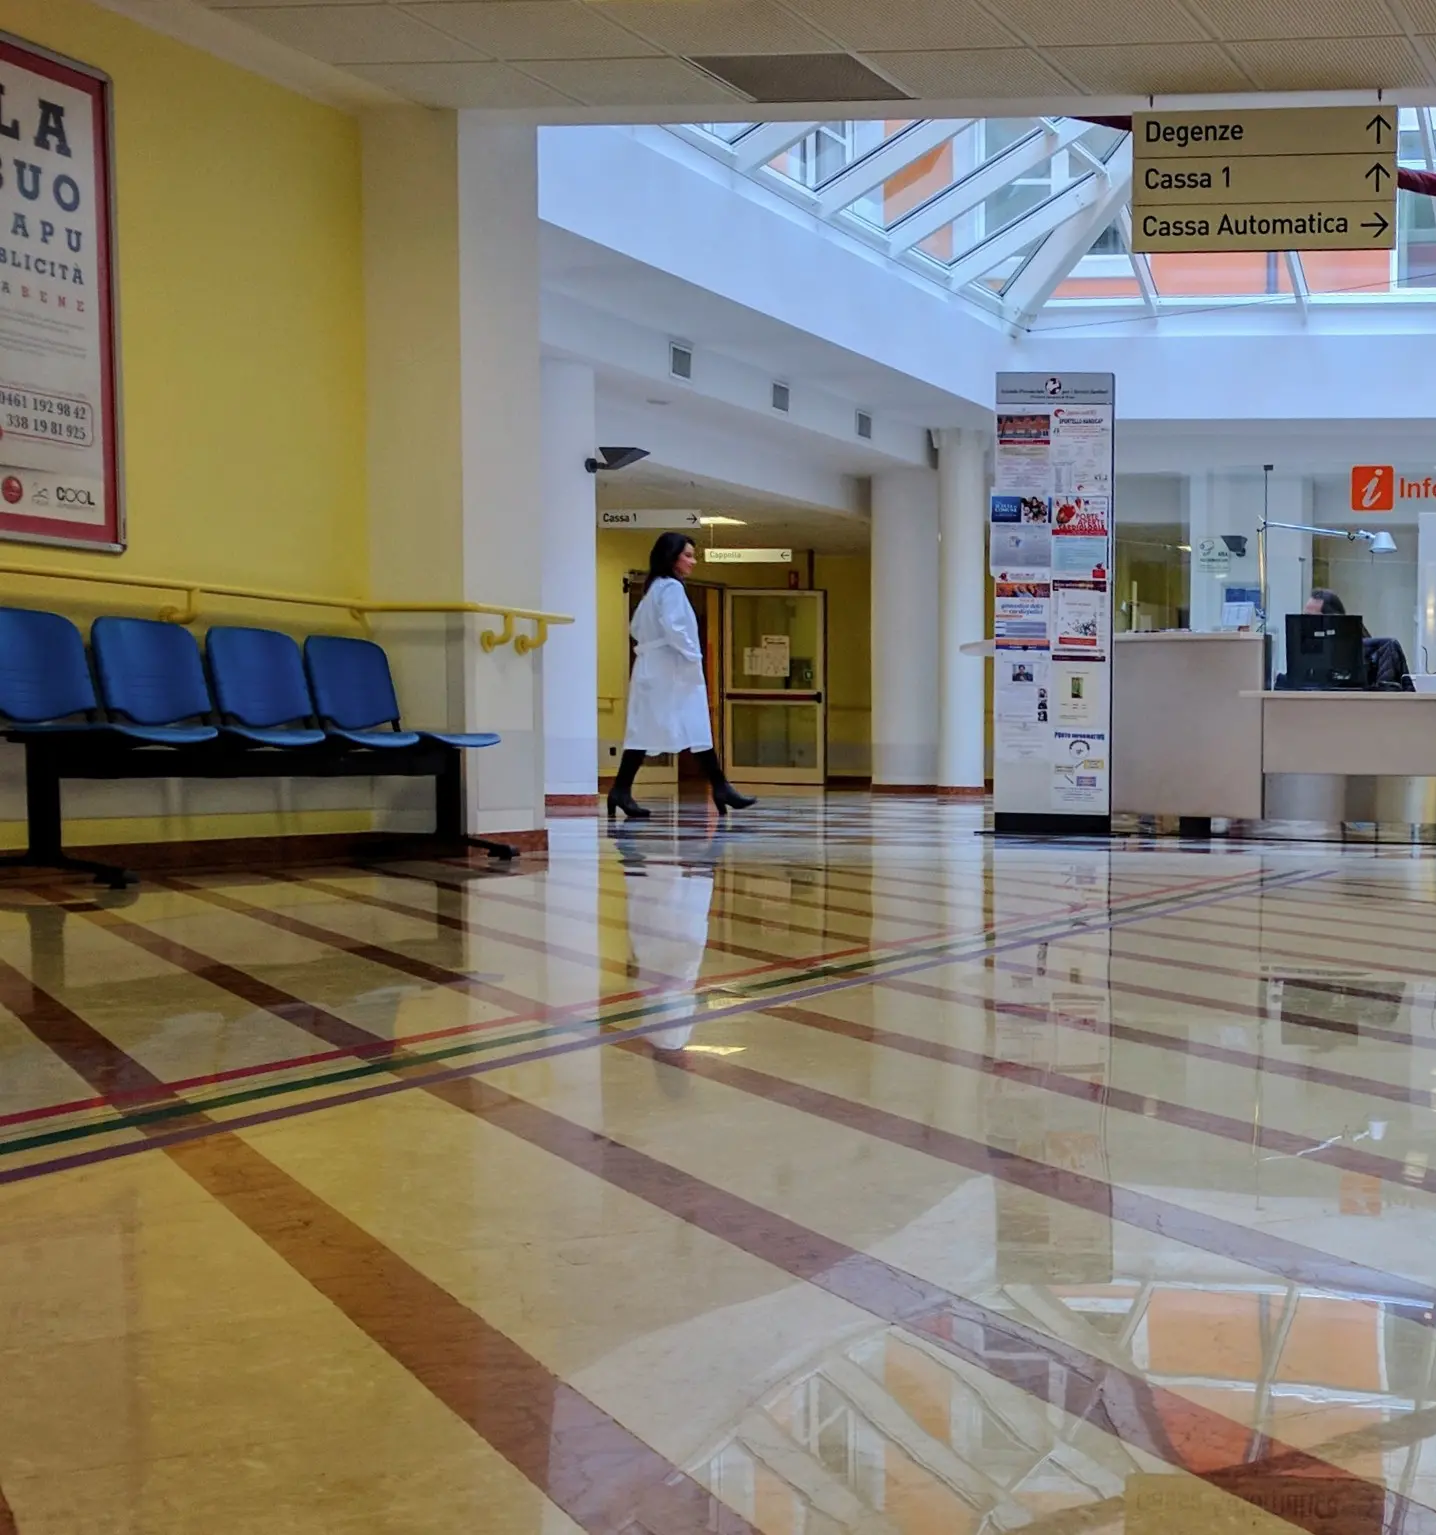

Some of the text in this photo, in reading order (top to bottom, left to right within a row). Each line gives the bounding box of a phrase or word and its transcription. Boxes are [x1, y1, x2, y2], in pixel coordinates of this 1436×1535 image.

[1146, 121, 1244, 147] Degenze
[0, 158, 80, 212] UO
[1145, 166, 1231, 189] Cassa 1
[1143, 213, 1348, 236] Cassa Automatica
[21, 285, 85, 312] BENE
[32, 398, 53, 413] 192
[57, 404, 70, 417] 98
[74, 407, 86, 420] 42
[6, 413, 86, 440] 338 19 81 925
[56, 486, 95, 506] COOL
[603, 513, 637, 523] Cassa 1
